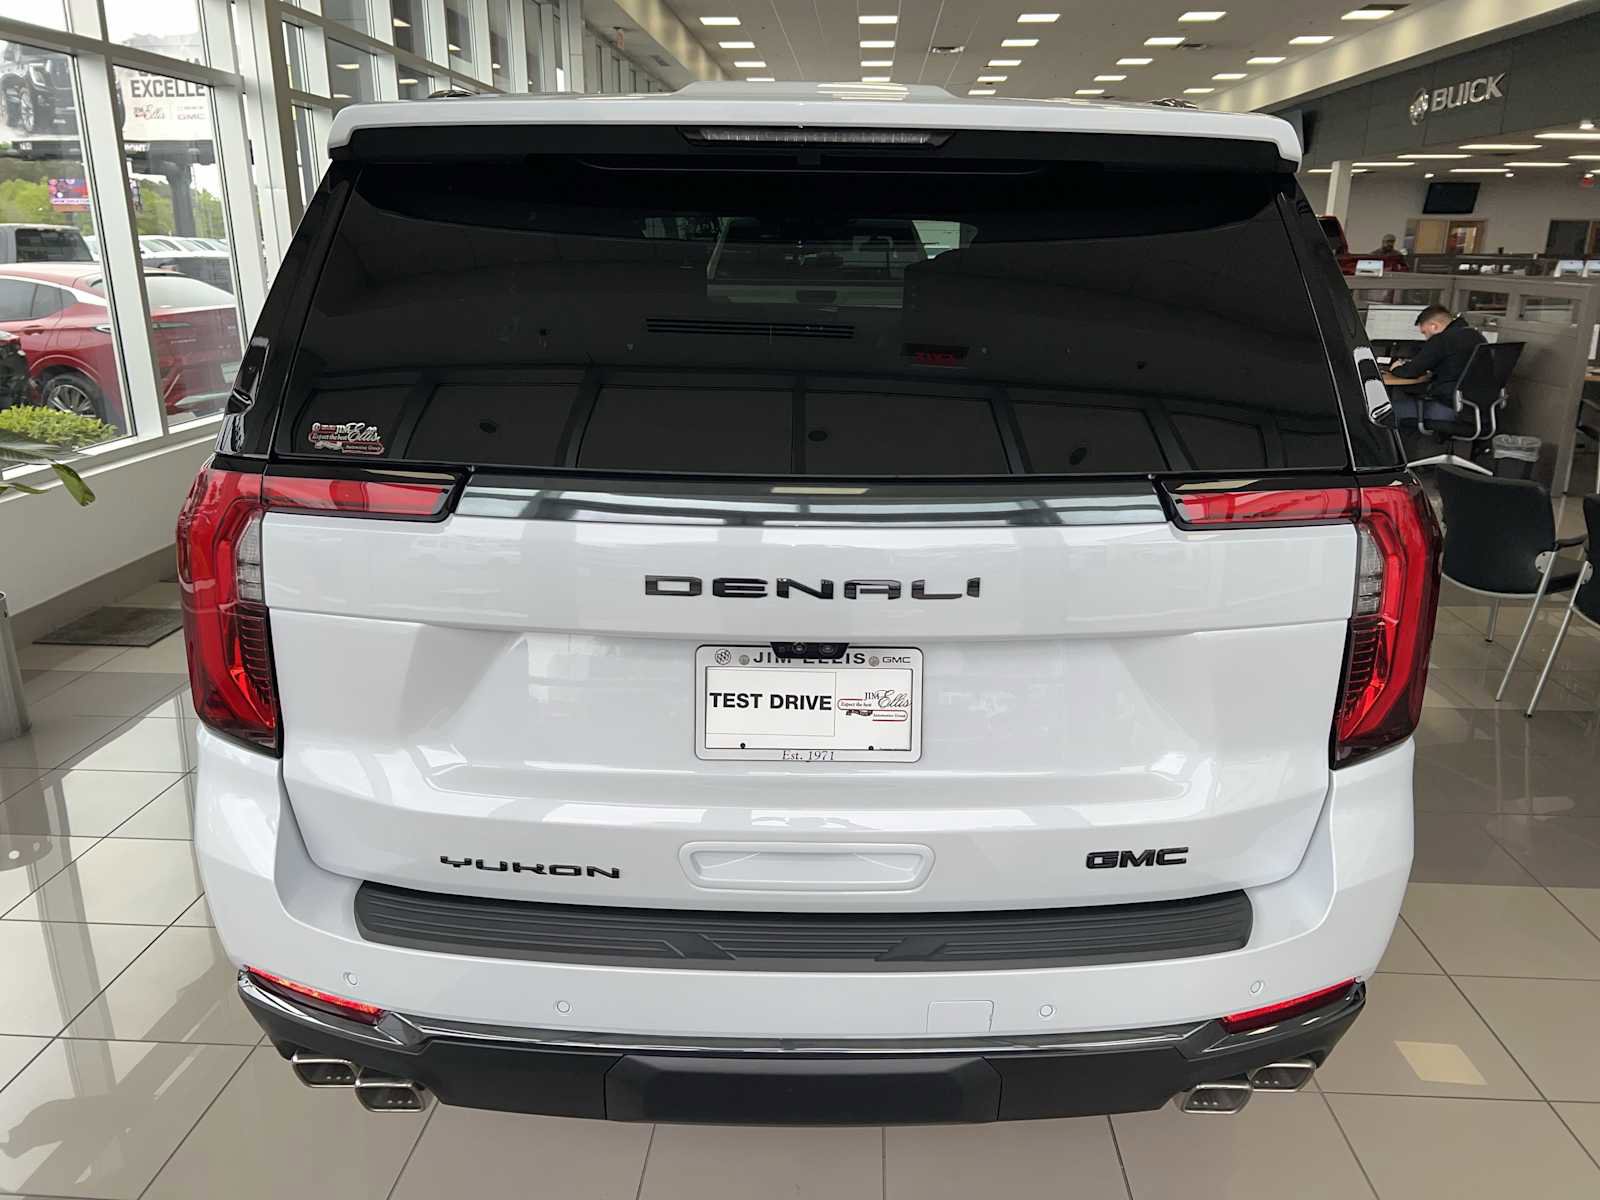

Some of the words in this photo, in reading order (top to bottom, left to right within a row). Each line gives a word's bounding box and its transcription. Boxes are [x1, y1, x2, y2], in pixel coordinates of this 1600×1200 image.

[1430, 72, 1506, 113] BUICK
[335, 424, 350, 434] JIM
[346, 422, 381, 442] Ellis
[645, 574, 981, 600] DENALI
[882, 656, 911, 664] GMC
[709, 692, 763, 709] TEST
[770, 693, 832, 711] DRIVE
[864, 692, 879, 700] JIM
[877, 689, 912, 709] Ellis
[782, 750, 803, 760] Est.
[808, 751, 835, 760] 1971
[440, 855, 620, 879] YUKON
[1086, 847, 1189, 869] GMC
